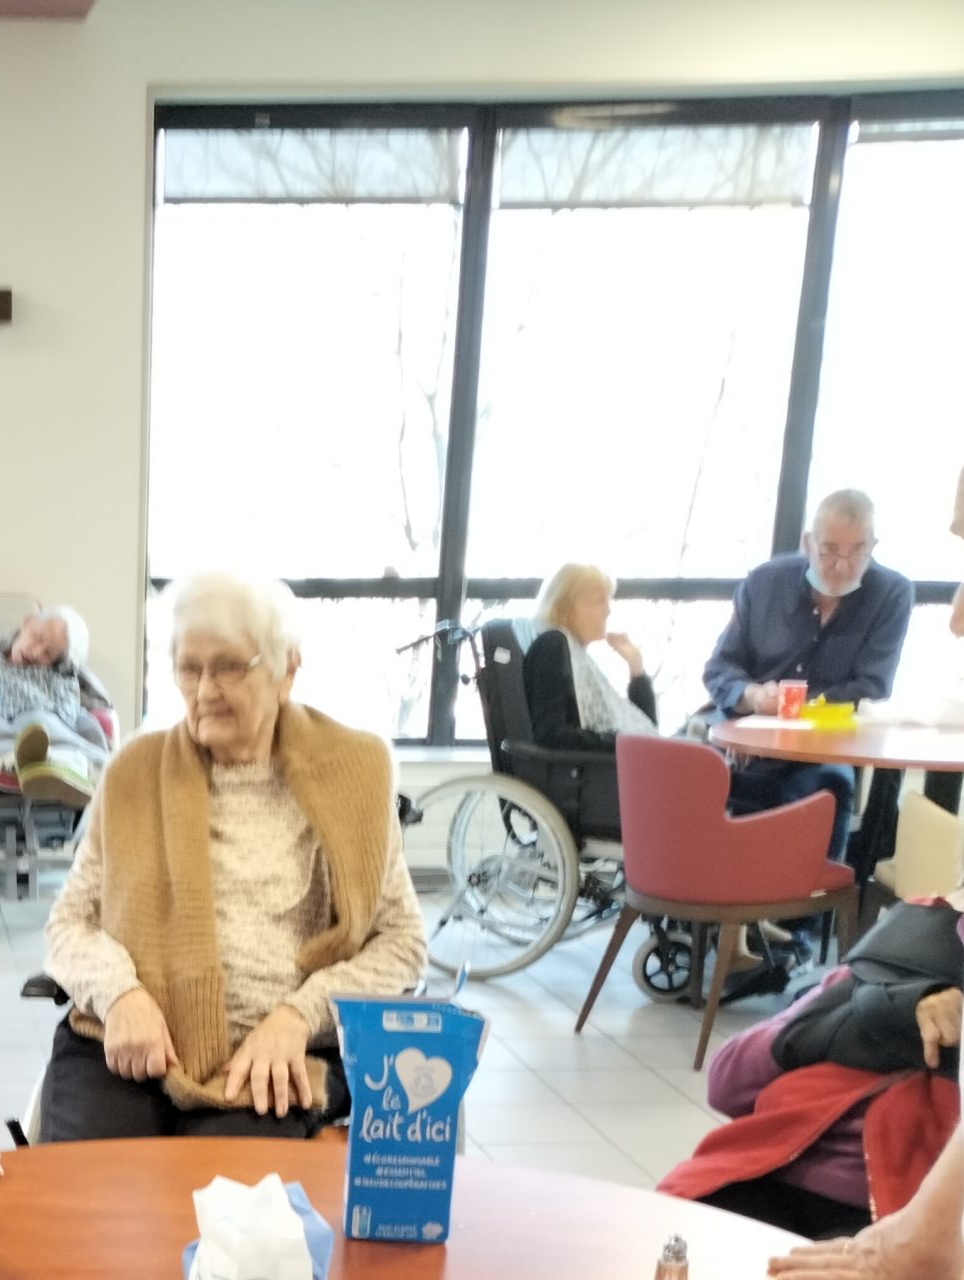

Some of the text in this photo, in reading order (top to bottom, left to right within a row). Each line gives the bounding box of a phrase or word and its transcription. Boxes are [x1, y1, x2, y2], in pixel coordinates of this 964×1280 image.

[381, 1086, 401, 1111] le
[358, 1104, 451, 1143] lait d'ici
